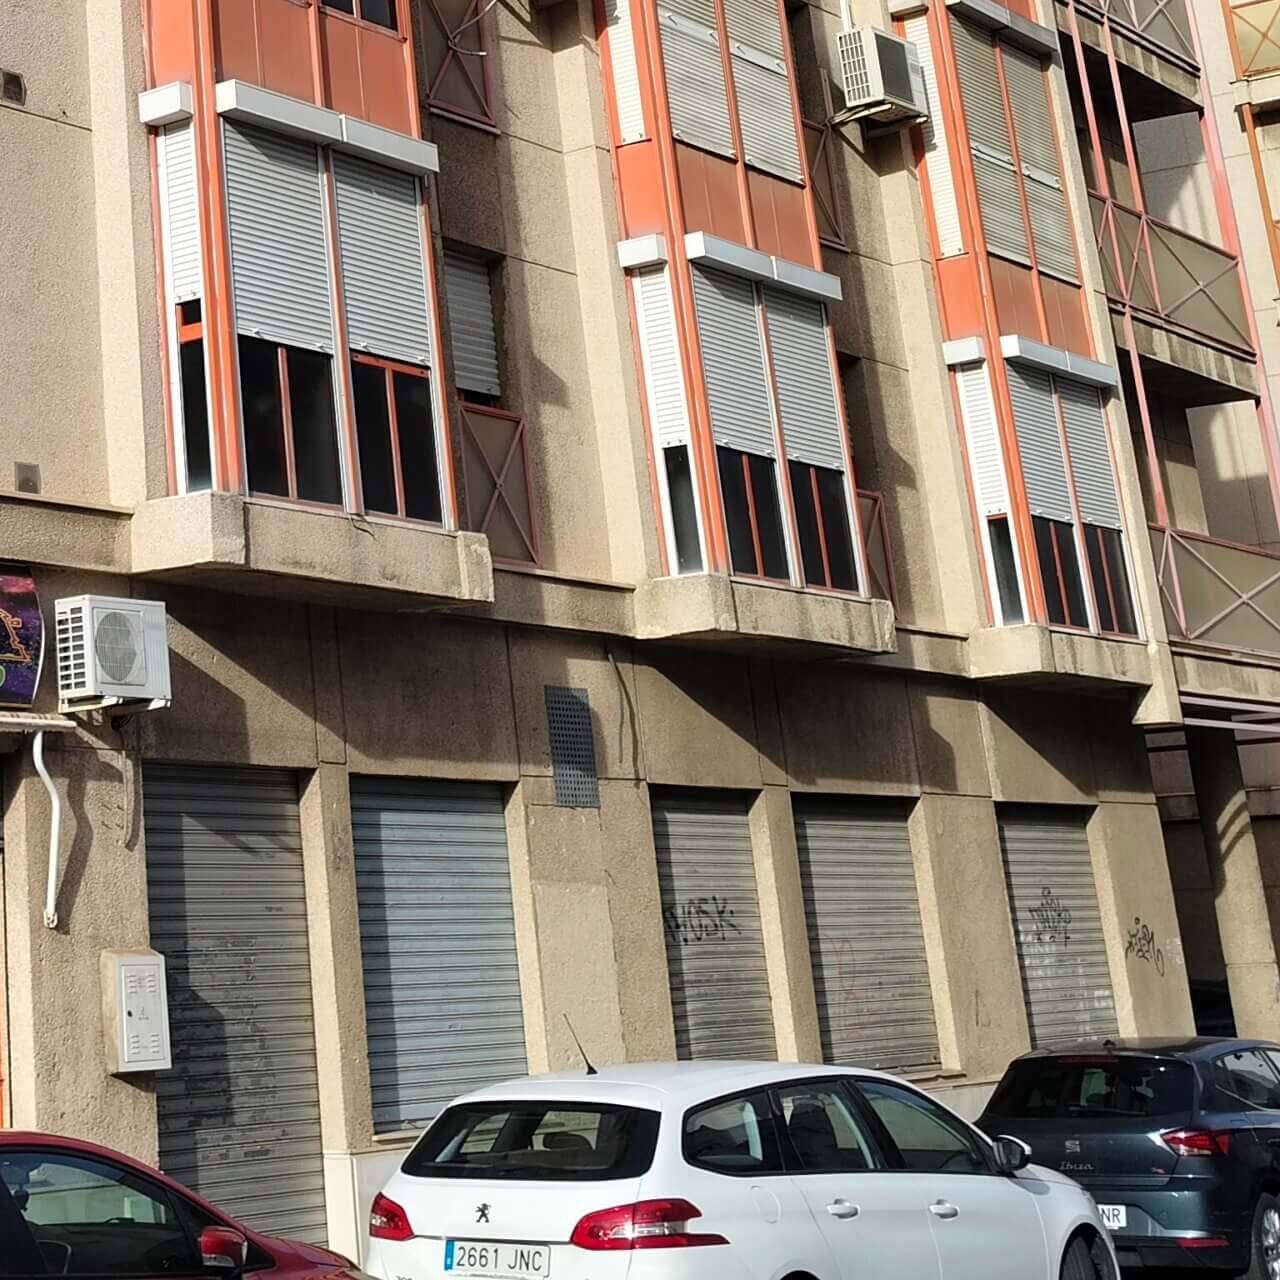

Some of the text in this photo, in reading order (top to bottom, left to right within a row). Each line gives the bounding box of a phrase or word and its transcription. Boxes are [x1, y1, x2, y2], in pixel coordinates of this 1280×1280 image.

[1060, 1161, 1094, 1170] Ibiza
[1099, 1207, 1122, 1224] NR
[456, 1246, 543, 1271] 2661 JNC
